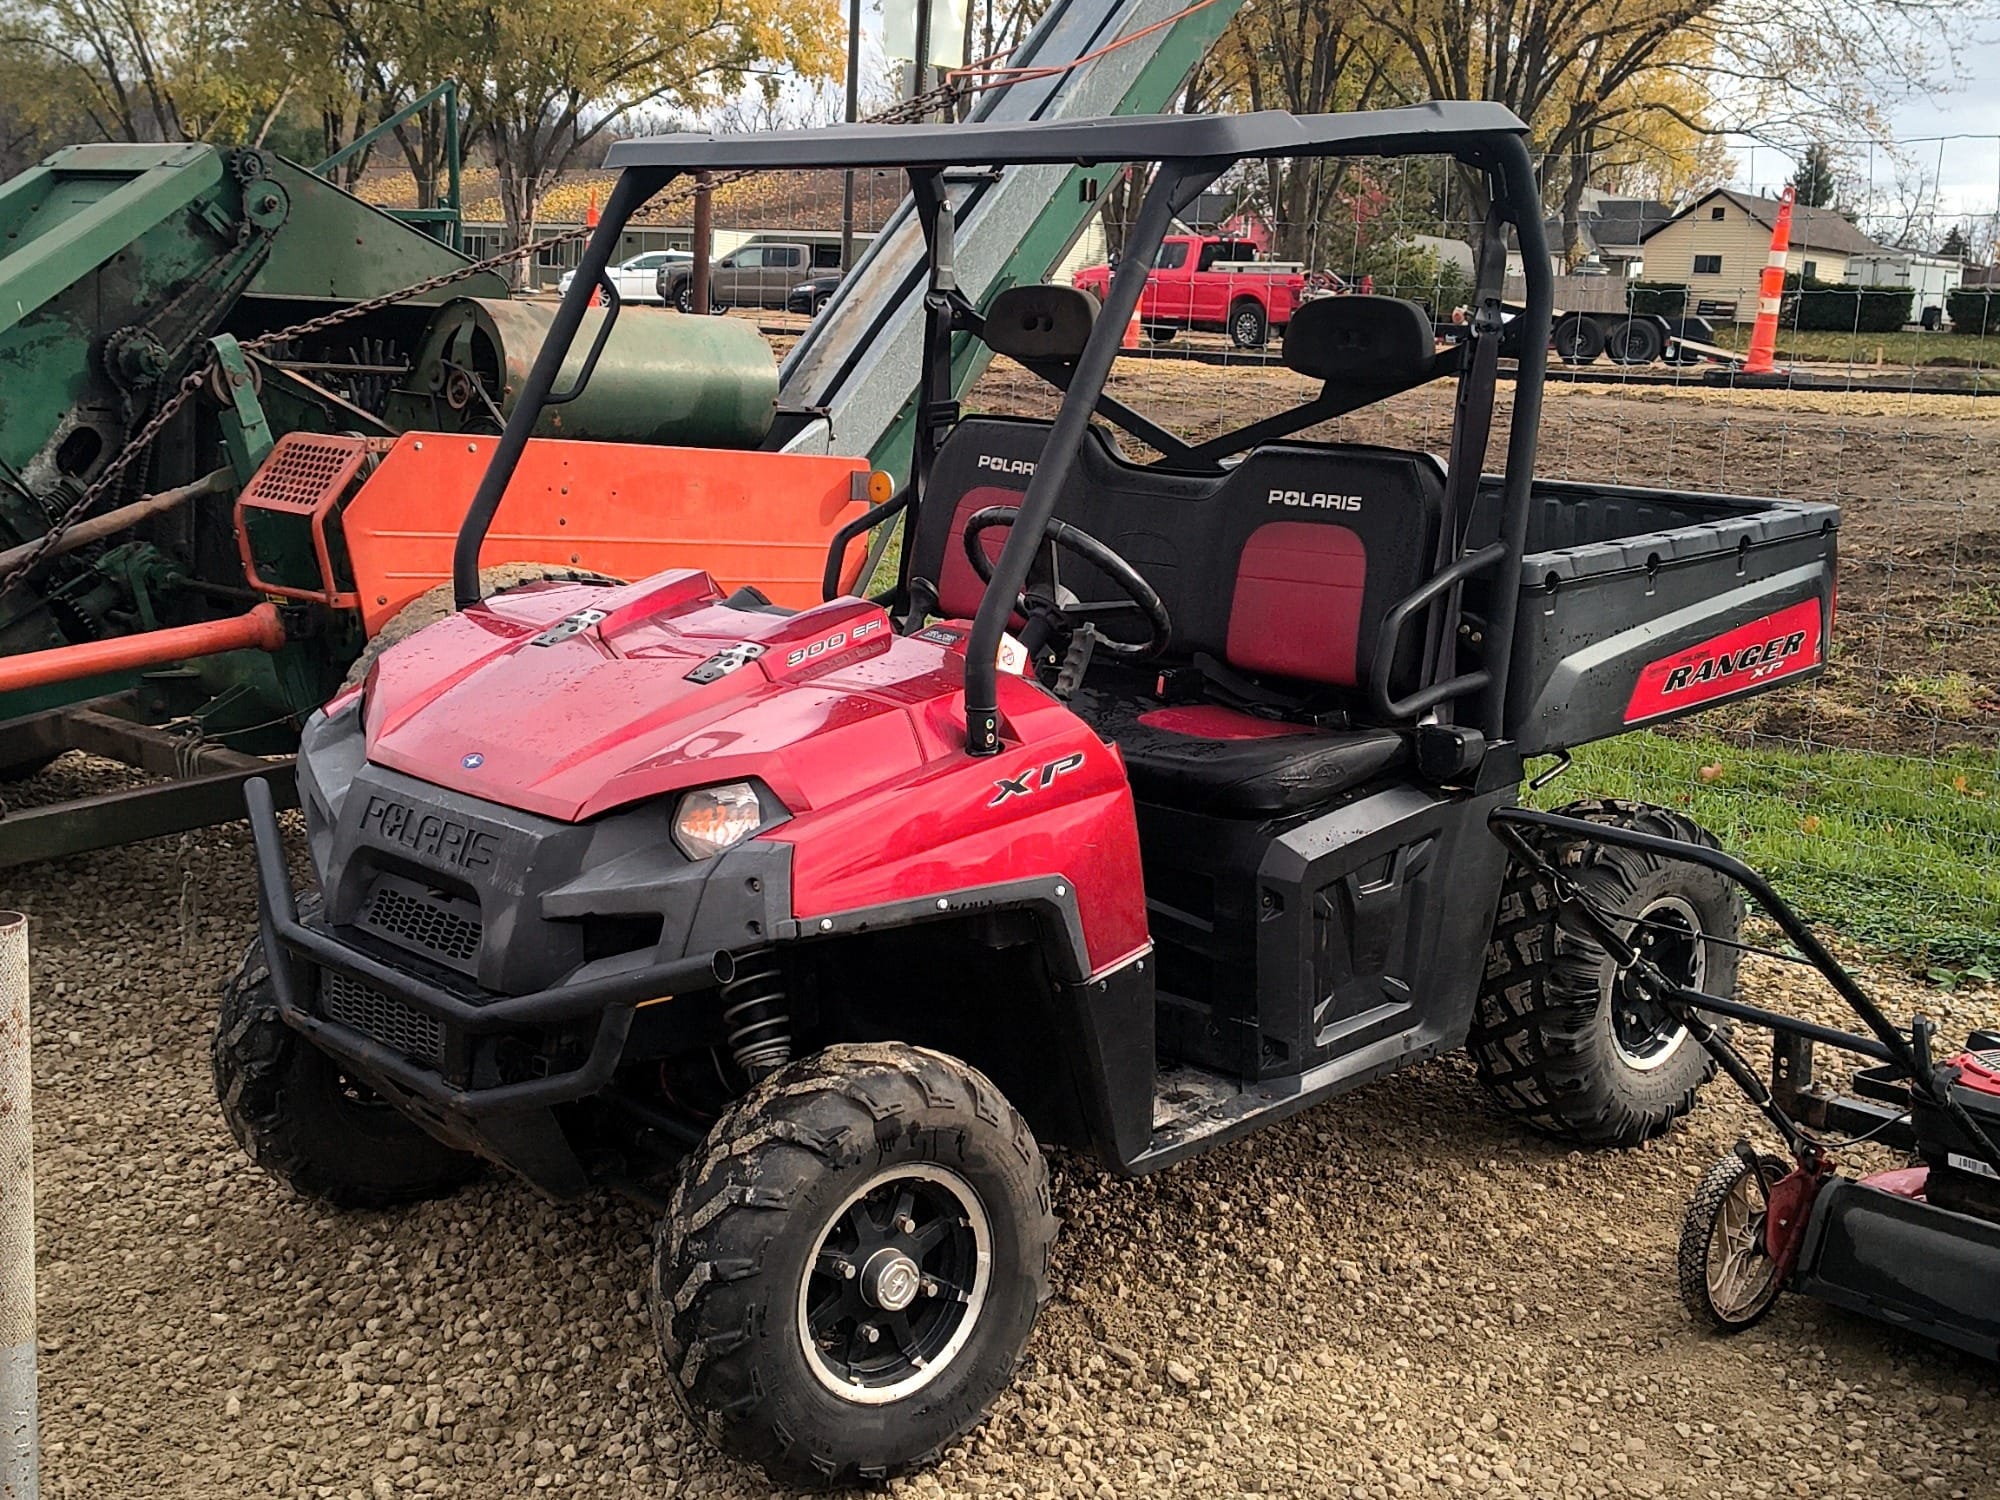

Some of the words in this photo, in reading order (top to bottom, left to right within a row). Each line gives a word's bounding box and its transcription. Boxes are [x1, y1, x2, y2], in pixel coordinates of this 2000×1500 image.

[1268, 489, 1362, 511] POLARIS
[787, 632, 847, 667] 900
[853, 619, 882, 639] EFI
[1661, 630, 1806, 695] RANGER
[1750, 661, 1784, 680] XP
[987, 751, 1085, 808] XP
[360, 795, 500, 870] POLARIS
